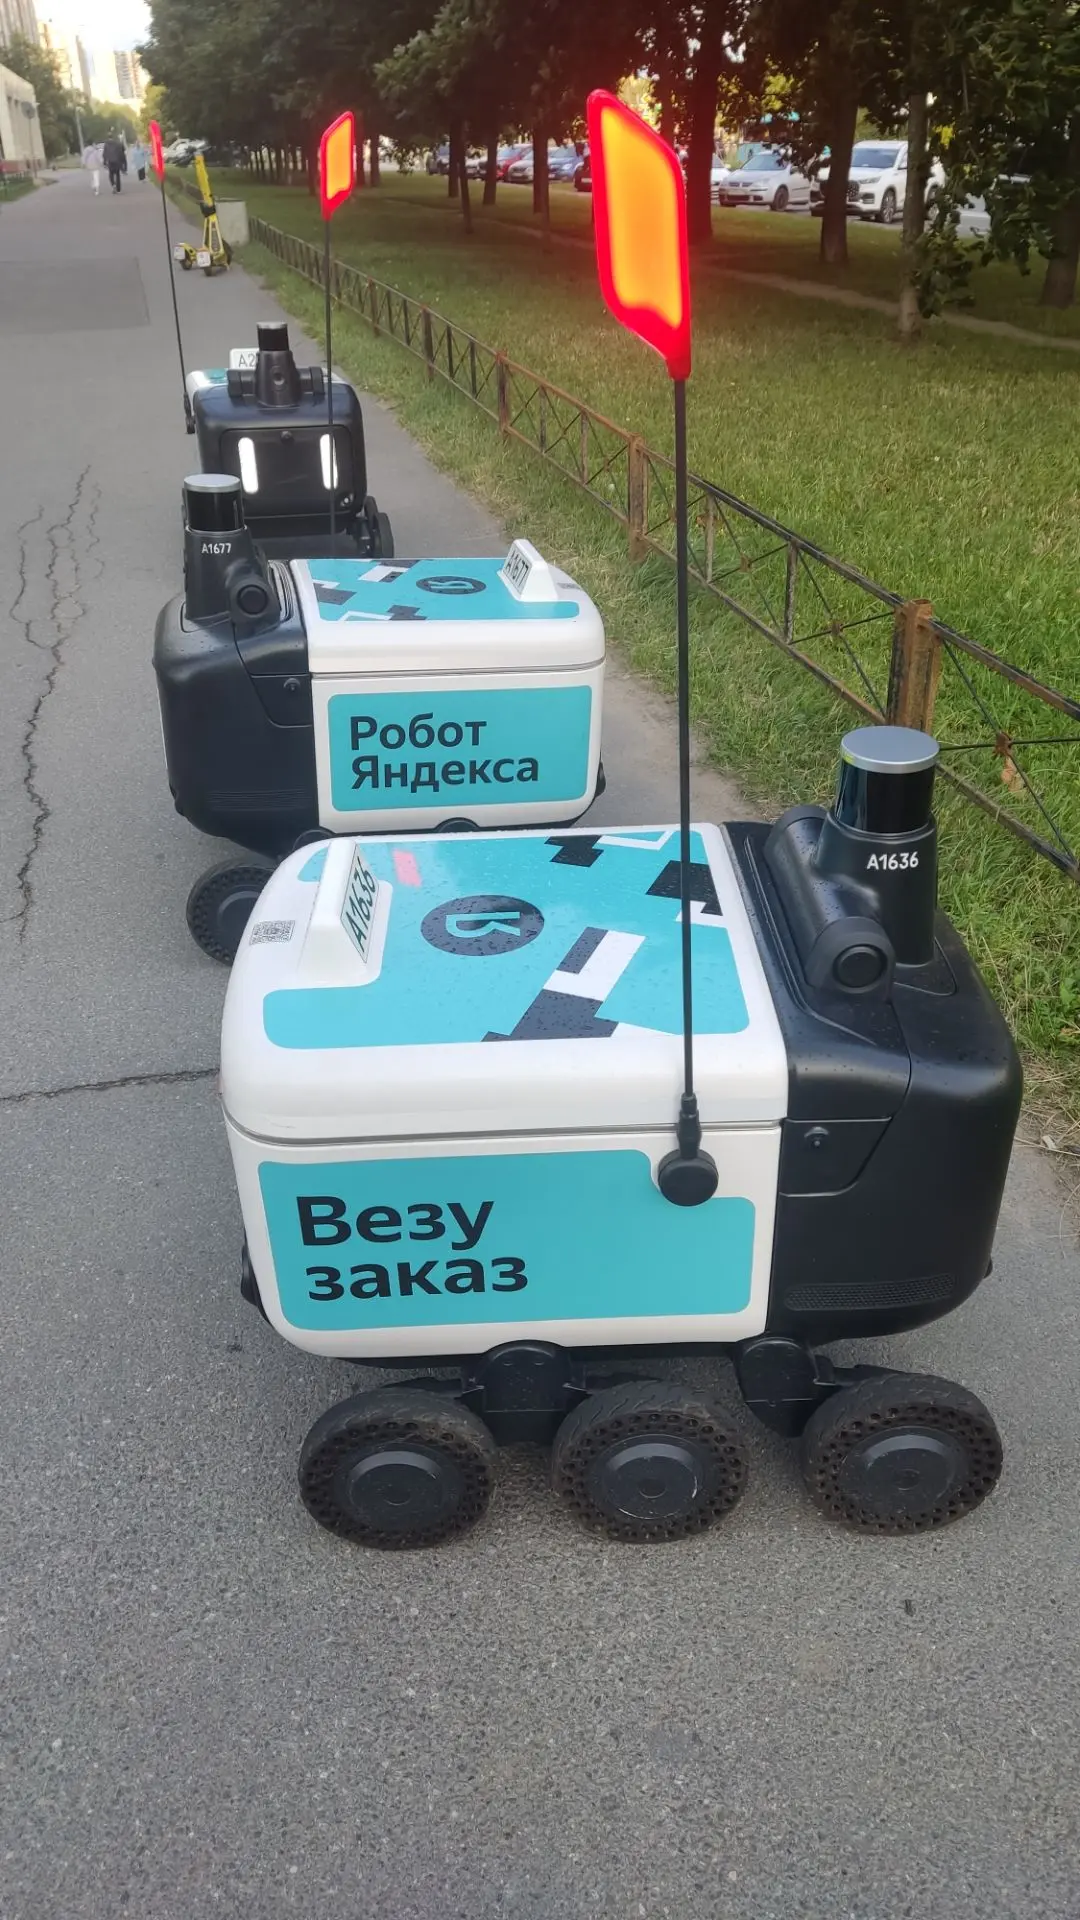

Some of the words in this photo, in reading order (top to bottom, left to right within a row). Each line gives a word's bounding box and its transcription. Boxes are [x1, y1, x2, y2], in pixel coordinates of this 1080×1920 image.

[239, 352, 257, 368] A2
[201, 543, 232, 554] A1677
[350, 712, 487, 750] Робот
[351, 755, 539, 793] Яндекса
[866, 851, 919, 870] A1636
[346, 856, 375, 953] A1636
[296, 1195, 494, 1251] Везу
[305, 1256, 528, 1301] заказ
